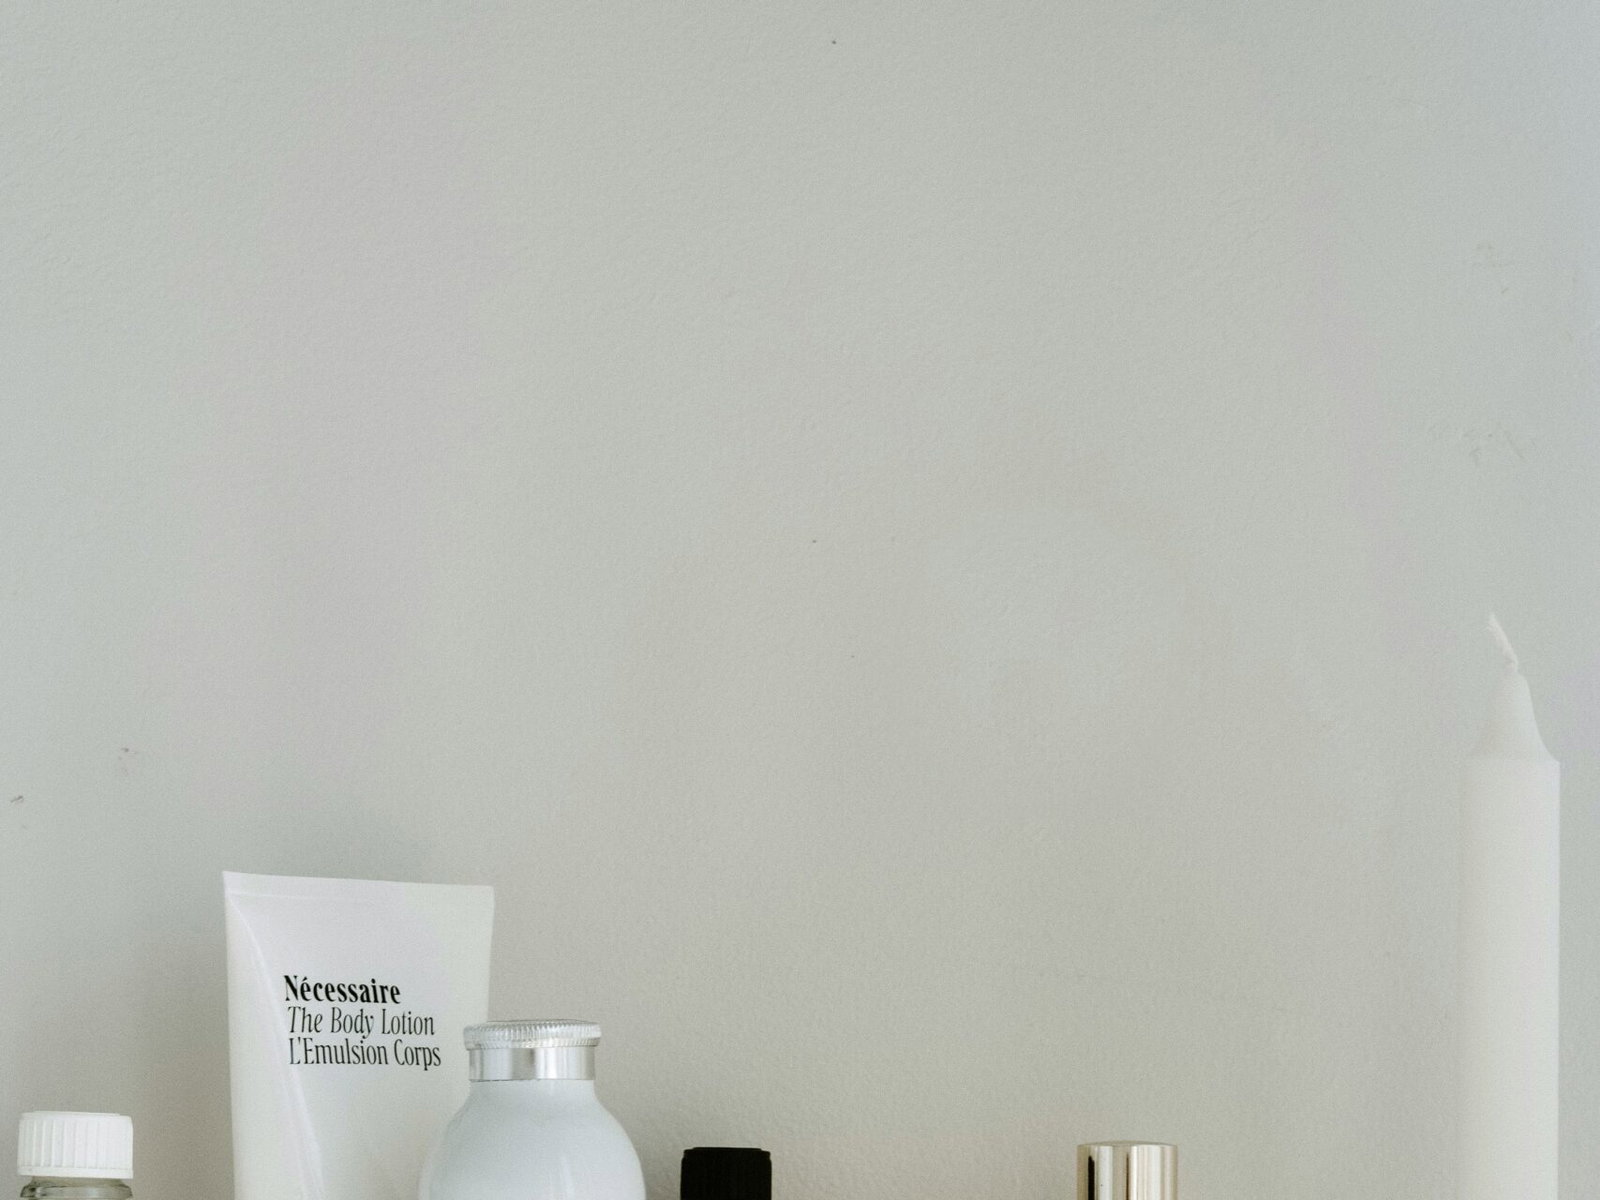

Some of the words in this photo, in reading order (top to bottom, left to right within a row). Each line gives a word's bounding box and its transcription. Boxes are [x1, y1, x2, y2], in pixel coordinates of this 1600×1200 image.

[284, 975, 401, 1004] Nécessaire
[288, 1006, 323, 1033] The
[330, 1007, 374, 1039] Body
[381, 1008, 435, 1036] Lotion
[289, 1037, 389, 1065] L'Emulsion
[394, 1039, 442, 1071] Corps
